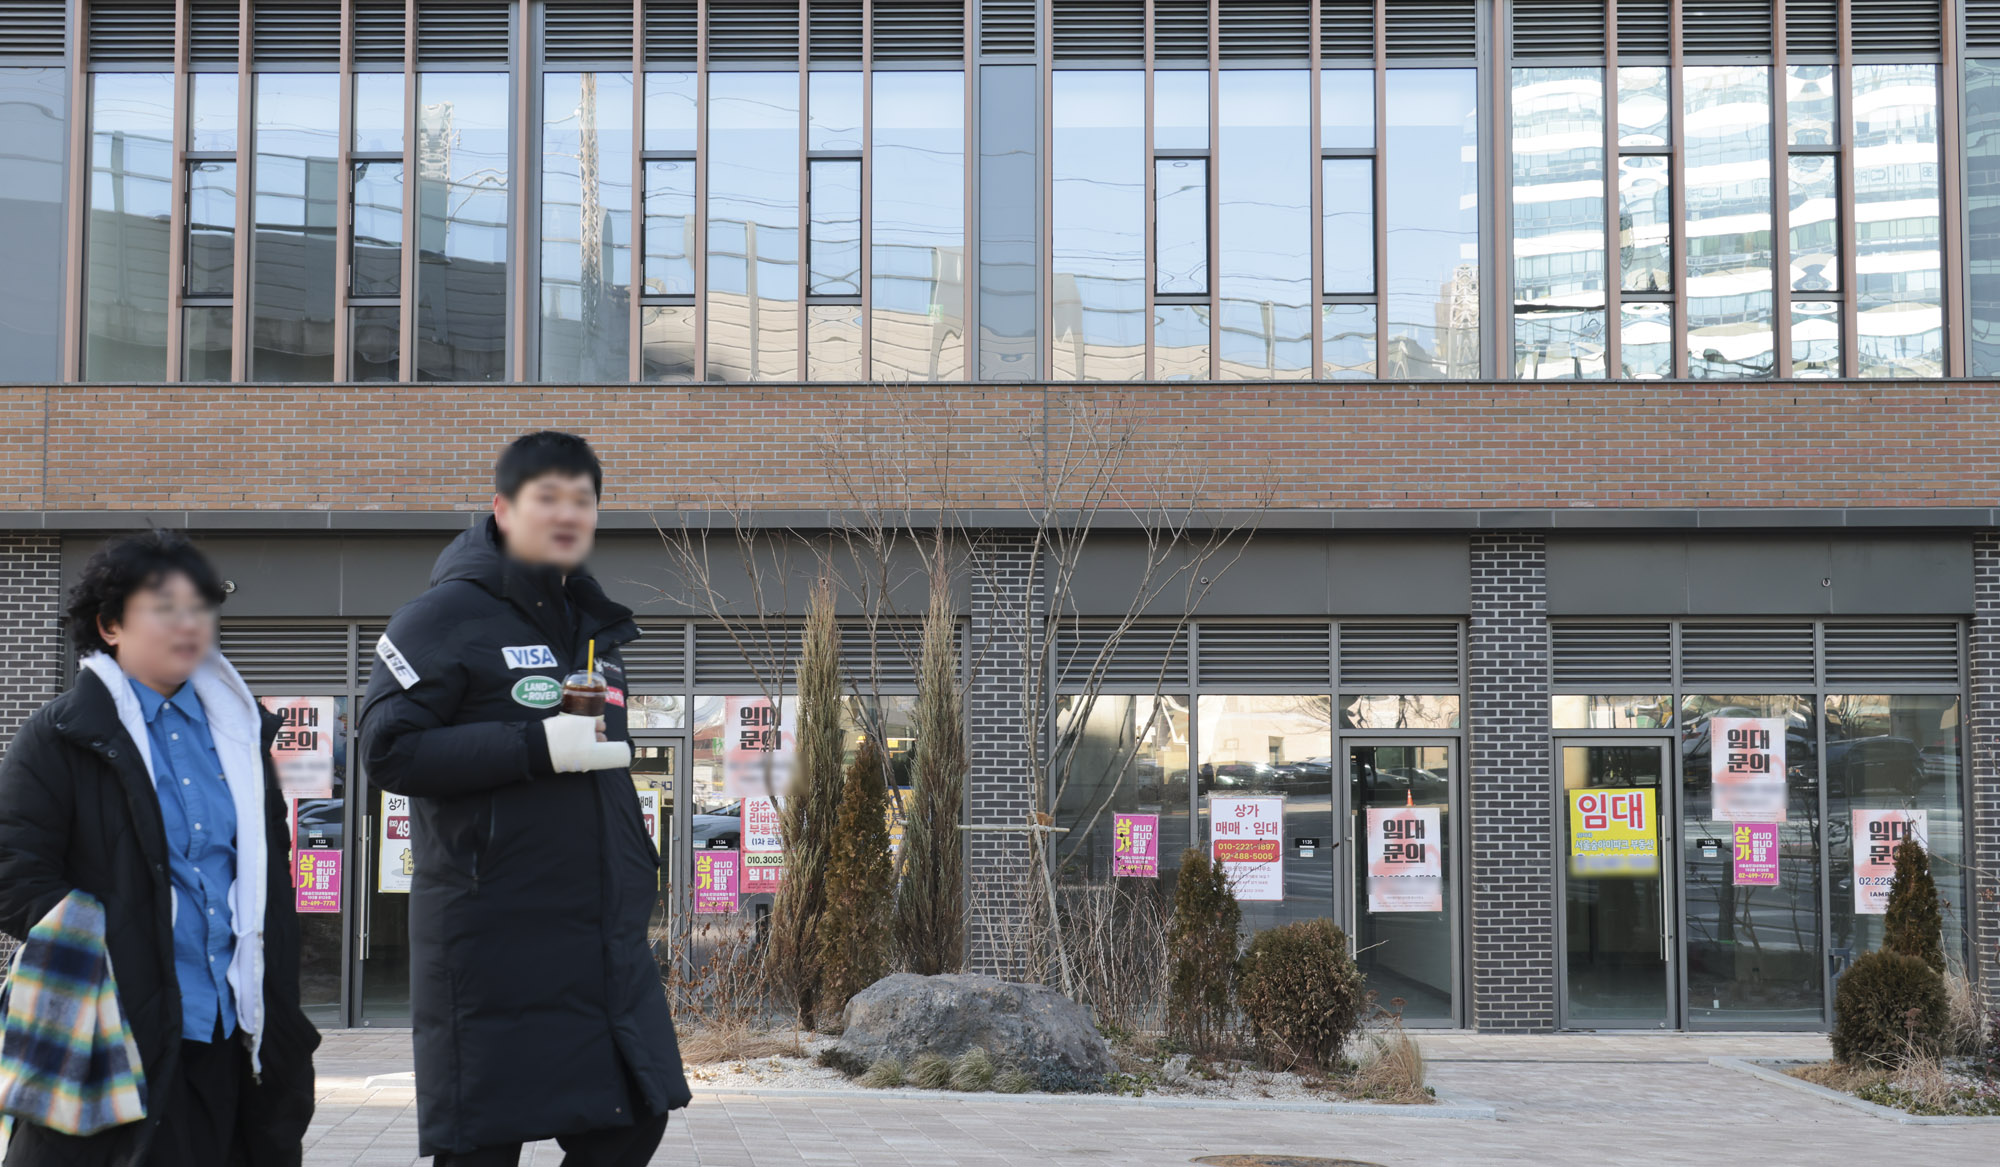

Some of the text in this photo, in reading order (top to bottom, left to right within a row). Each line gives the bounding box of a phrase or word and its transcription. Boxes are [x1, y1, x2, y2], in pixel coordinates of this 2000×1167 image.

[506, 648, 554, 665] VISA
[524, 682, 548, 691] LAND
[528, 691, 558, 700] ROVER
[277, 707, 318, 727] 임대
[740, 706, 781, 726] 임대
[276, 731, 318, 750] 문의
[740, 730, 781, 750] 문의
[1727, 729, 1770, 750] 임대
[1727, 753, 1770, 774] 문의
[388, 797, 406, 811] 상가
[749, 801, 770, 813] 성수
[1234, 804, 1259, 818] 상가
[1577, 792, 1645, 831] 임대
[1116, 818, 1132, 853] 상가
[1215, 821, 1240, 835] 매매
[1253, 821, 1278, 836] 임대
[1383, 819, 1425, 839] 임대
[1869, 821, 1912, 841] 임대
[1383, 843, 1426, 863] 문의
[1735, 826, 1752, 861] 상가
[1221, 852, 1273, 860] 02-488-5005
[299, 854, 316, 889] 상가
[697, 855, 713, 890] 상가
